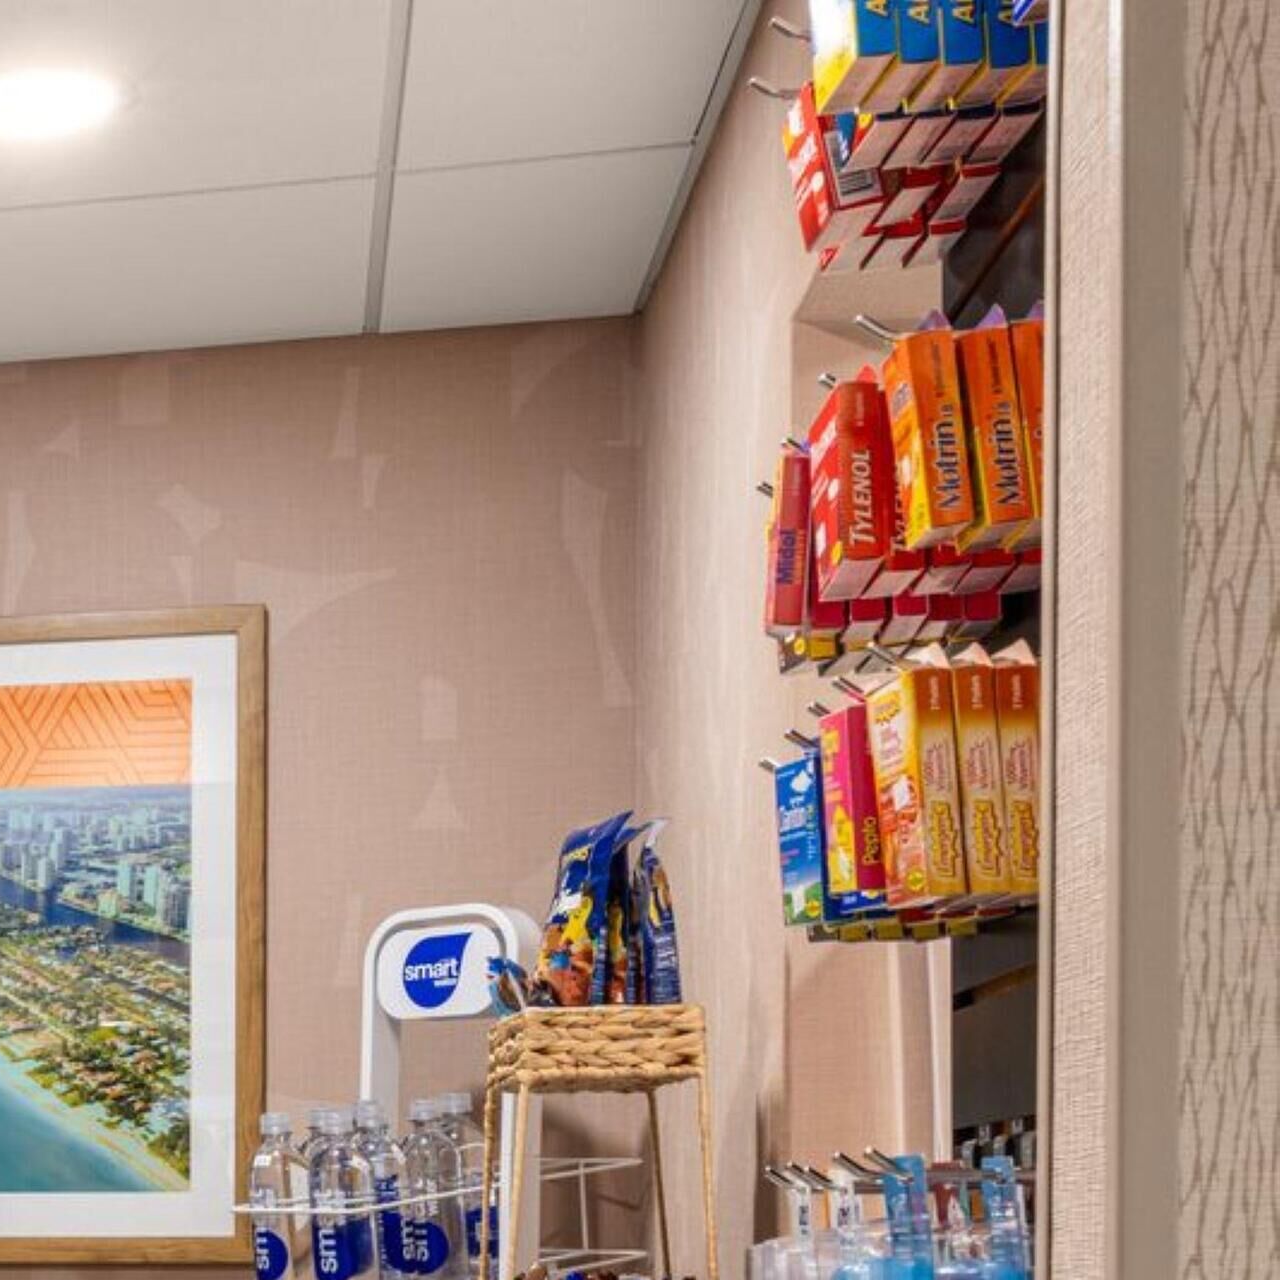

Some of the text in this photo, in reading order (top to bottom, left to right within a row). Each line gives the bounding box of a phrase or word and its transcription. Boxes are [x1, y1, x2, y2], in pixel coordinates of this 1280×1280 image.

[850, 449, 875, 547] TYLENOL
[931, 419, 961, 511] Motrin
[988, 416, 1021, 507] Motrin
[864, 816, 880, 865] Pepto
[405, 957, 459, 981] smart
